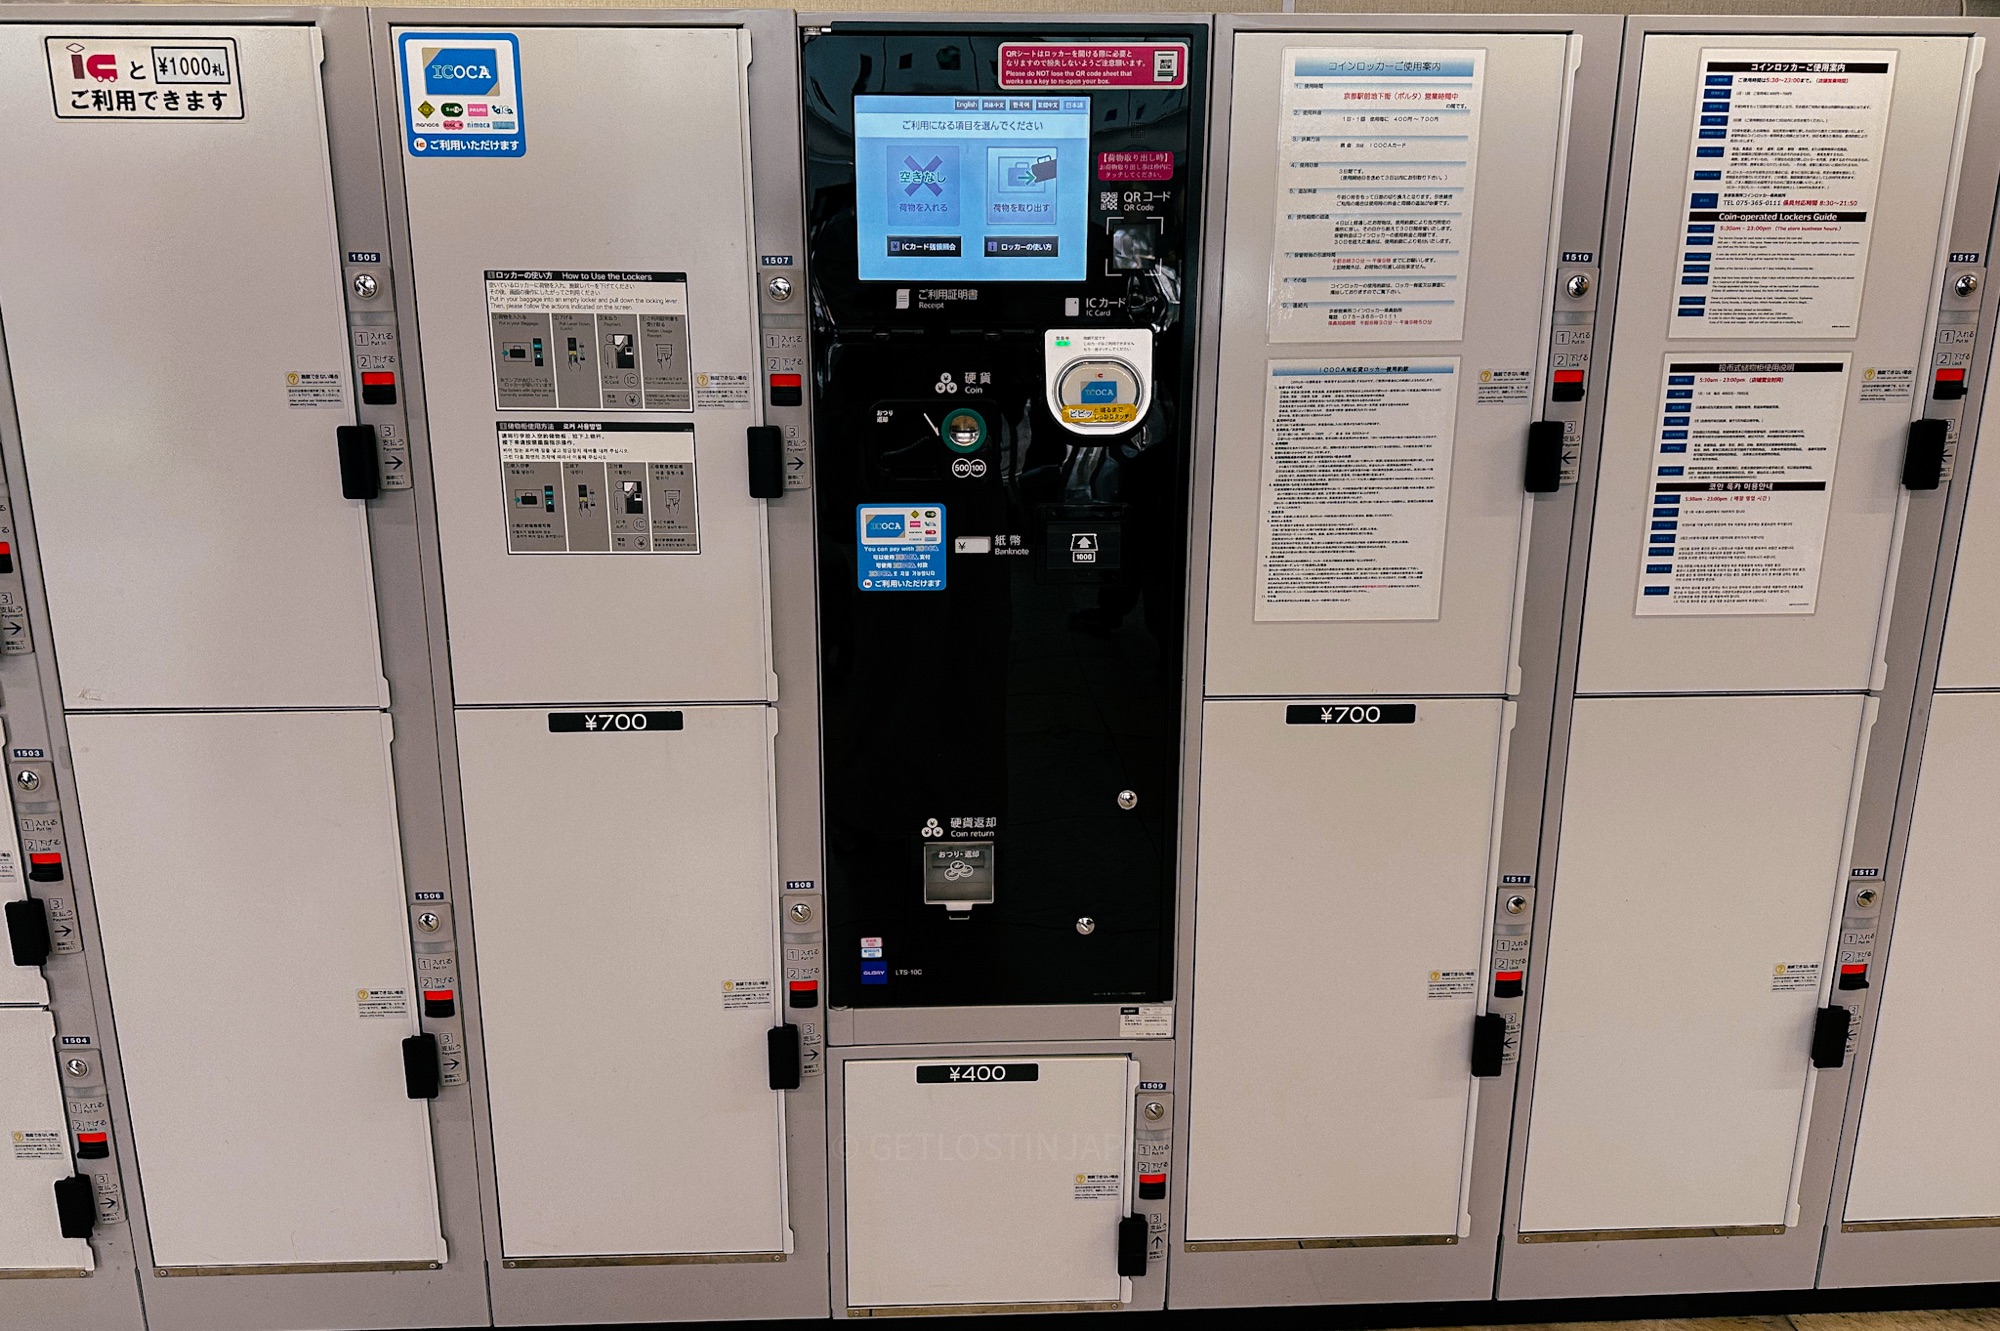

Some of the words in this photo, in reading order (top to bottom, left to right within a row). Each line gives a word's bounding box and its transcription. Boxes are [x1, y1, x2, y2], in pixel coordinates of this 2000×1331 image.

[130, 61, 146, 79] と
[432, 64, 491, 79] ICOCA
[1328, 61, 1441, 72] コインロッカーご使用案内
[1751, 62, 1846, 73] コインロッカーご使用案内
[1076, 70, 1086, 78] QR
[1039, 79, 1049, 87] key
[1058, 79, 1081, 87] re-open
[71, 90, 227, 111] ご利用できます
[956, 101, 978, 109] English
[1012, 101, 1030, 109] 한국어
[1066, 101, 1084, 109] 日本語
[902, 120, 1043, 132] ご利用になる項目を選んでください
[430, 139, 519, 151] ご利用いただけます
[1104, 153, 1168, 163] 【荷物取り出し時】
[899, 171, 946, 184] 空きなし
[1106, 171, 1162, 179] タッチしてください。
[1124, 191, 1141, 203] QR
[1143, 191, 1172, 202] コード
[899, 203, 948, 213] 荷物を入れる
[993, 203, 1050, 213] 荷物を取り出す
[1124, 204, 1135, 212] QR
[1719, 213, 1777, 223] Coin-operated
[1779, 213, 1812, 222] Lockers
[1813, 213, 1838, 222] Guide
[1001, 243, 1052, 251] ロッカーの使い方
[351, 253, 377, 262] 1505
[1565, 254, 1590, 262] 1510
[1952, 254, 1976, 262] 1512
[496, 271, 552, 280] ロッカーの使い方
[562, 272, 578, 281] How
[580, 273, 590, 281] to
[591, 273, 606, 281] Use
[607, 273, 621, 282] the
[622, 273, 653, 282] Lockers
[519, 296, 542, 304] baggage
[919, 289, 978, 301] ご利用証明書
[919, 302, 945, 310] Receipt
[1086, 298, 1097, 308] IC
[1098, 297, 1126, 308] カード
[370, 332, 393, 341] 入れる
[965, 372, 991, 384] 硬貨
[965, 386, 983, 394] Coin
[1085, 389, 1114, 397] ICOCA
[955, 464, 969, 472] 500
[870, 522, 901, 530] ICOCA
[995, 548, 1030, 556] Banknote
[875, 580, 942, 588] ご利用いただけます
[1321, 706, 1381, 723] ¥700
[585, 713, 647, 731] ¥700
[950, 817, 997, 829] 硬貨返却
[951, 830, 968, 838] Coin
[970, 830, 995, 838] return
[949, 1066, 1006, 1082] ¥400
